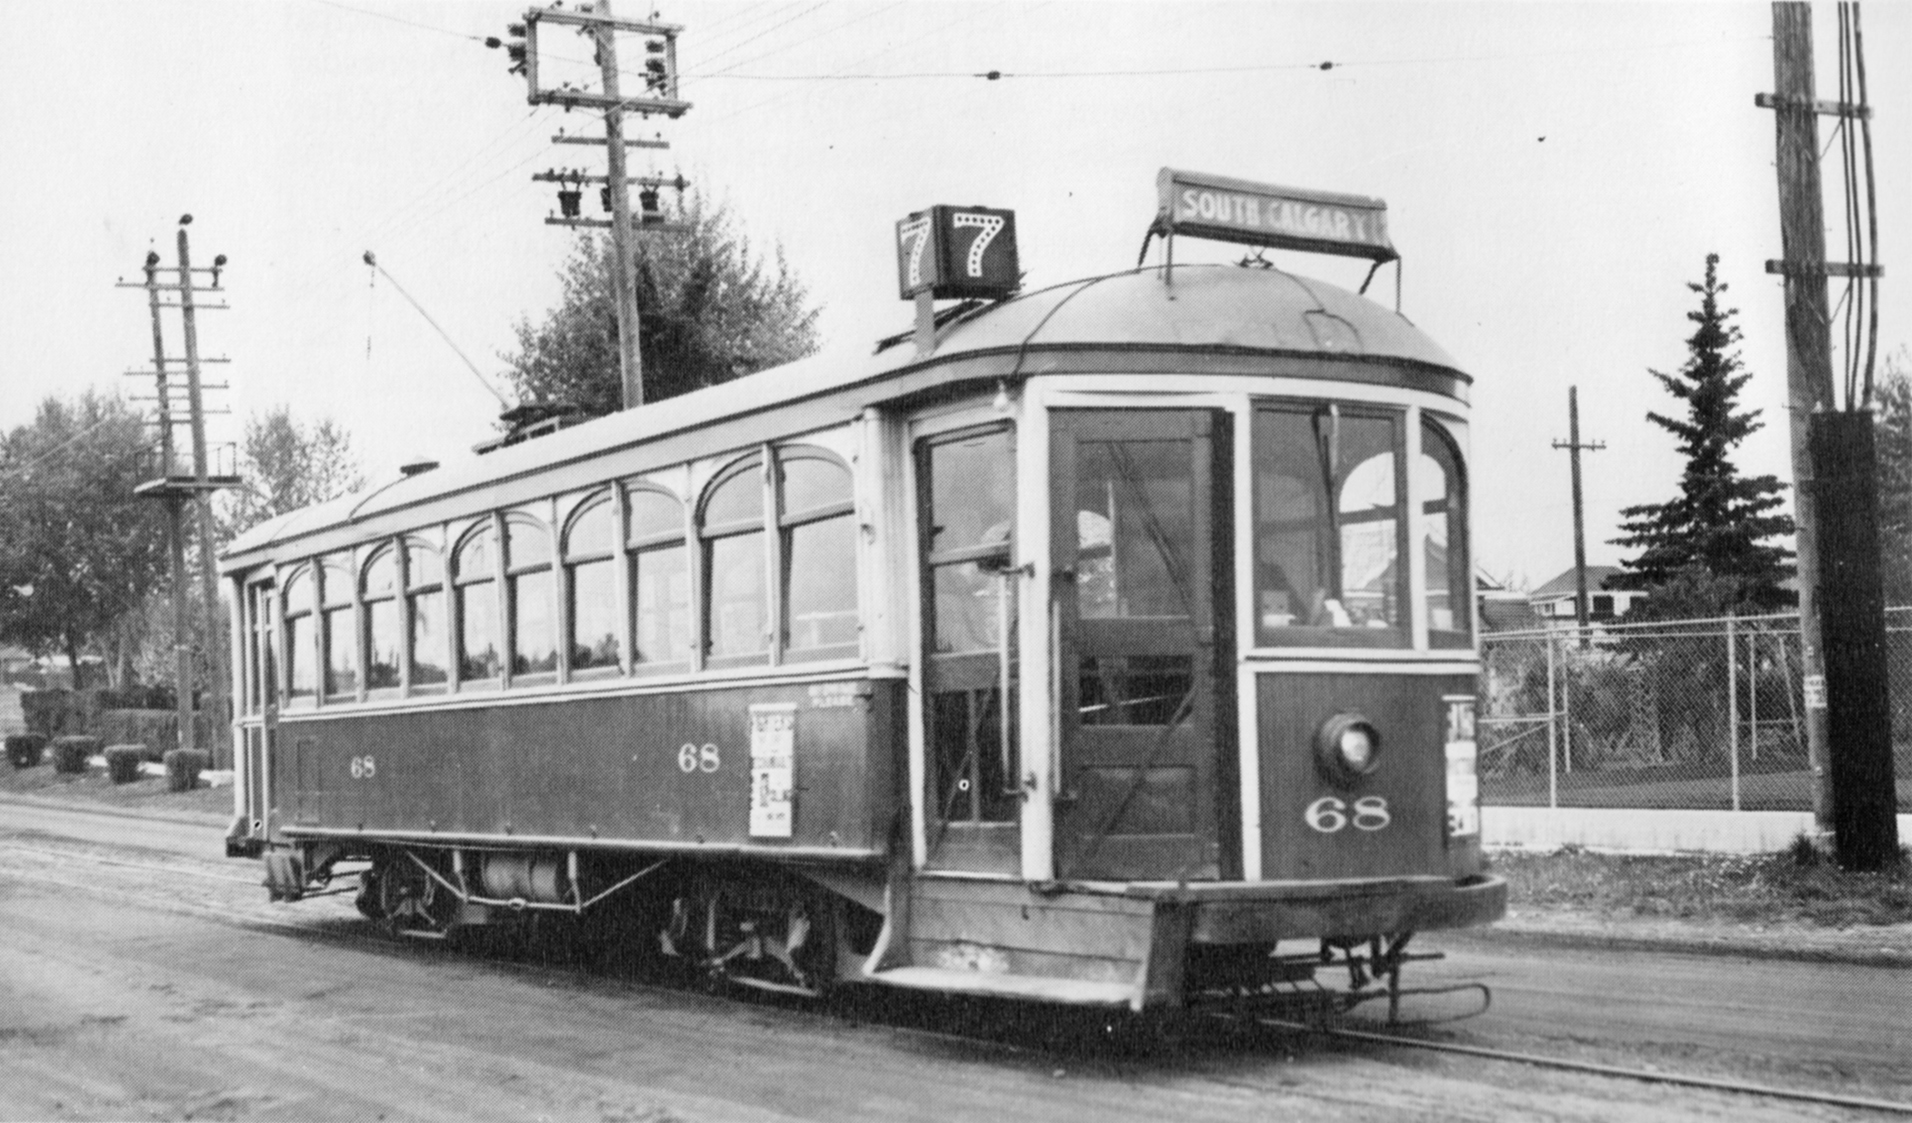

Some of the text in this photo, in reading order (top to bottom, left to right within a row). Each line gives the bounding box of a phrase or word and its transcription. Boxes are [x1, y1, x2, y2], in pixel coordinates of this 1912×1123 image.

[1183, 189, 1366, 241] SOUTH CALGARY
[900, 216, 931, 287] 7
[953, 212, 1005, 278] 7
[351, 755, 375, 779] 68
[678, 742, 720, 773] 68
[1305, 796, 1390, 833] 68
